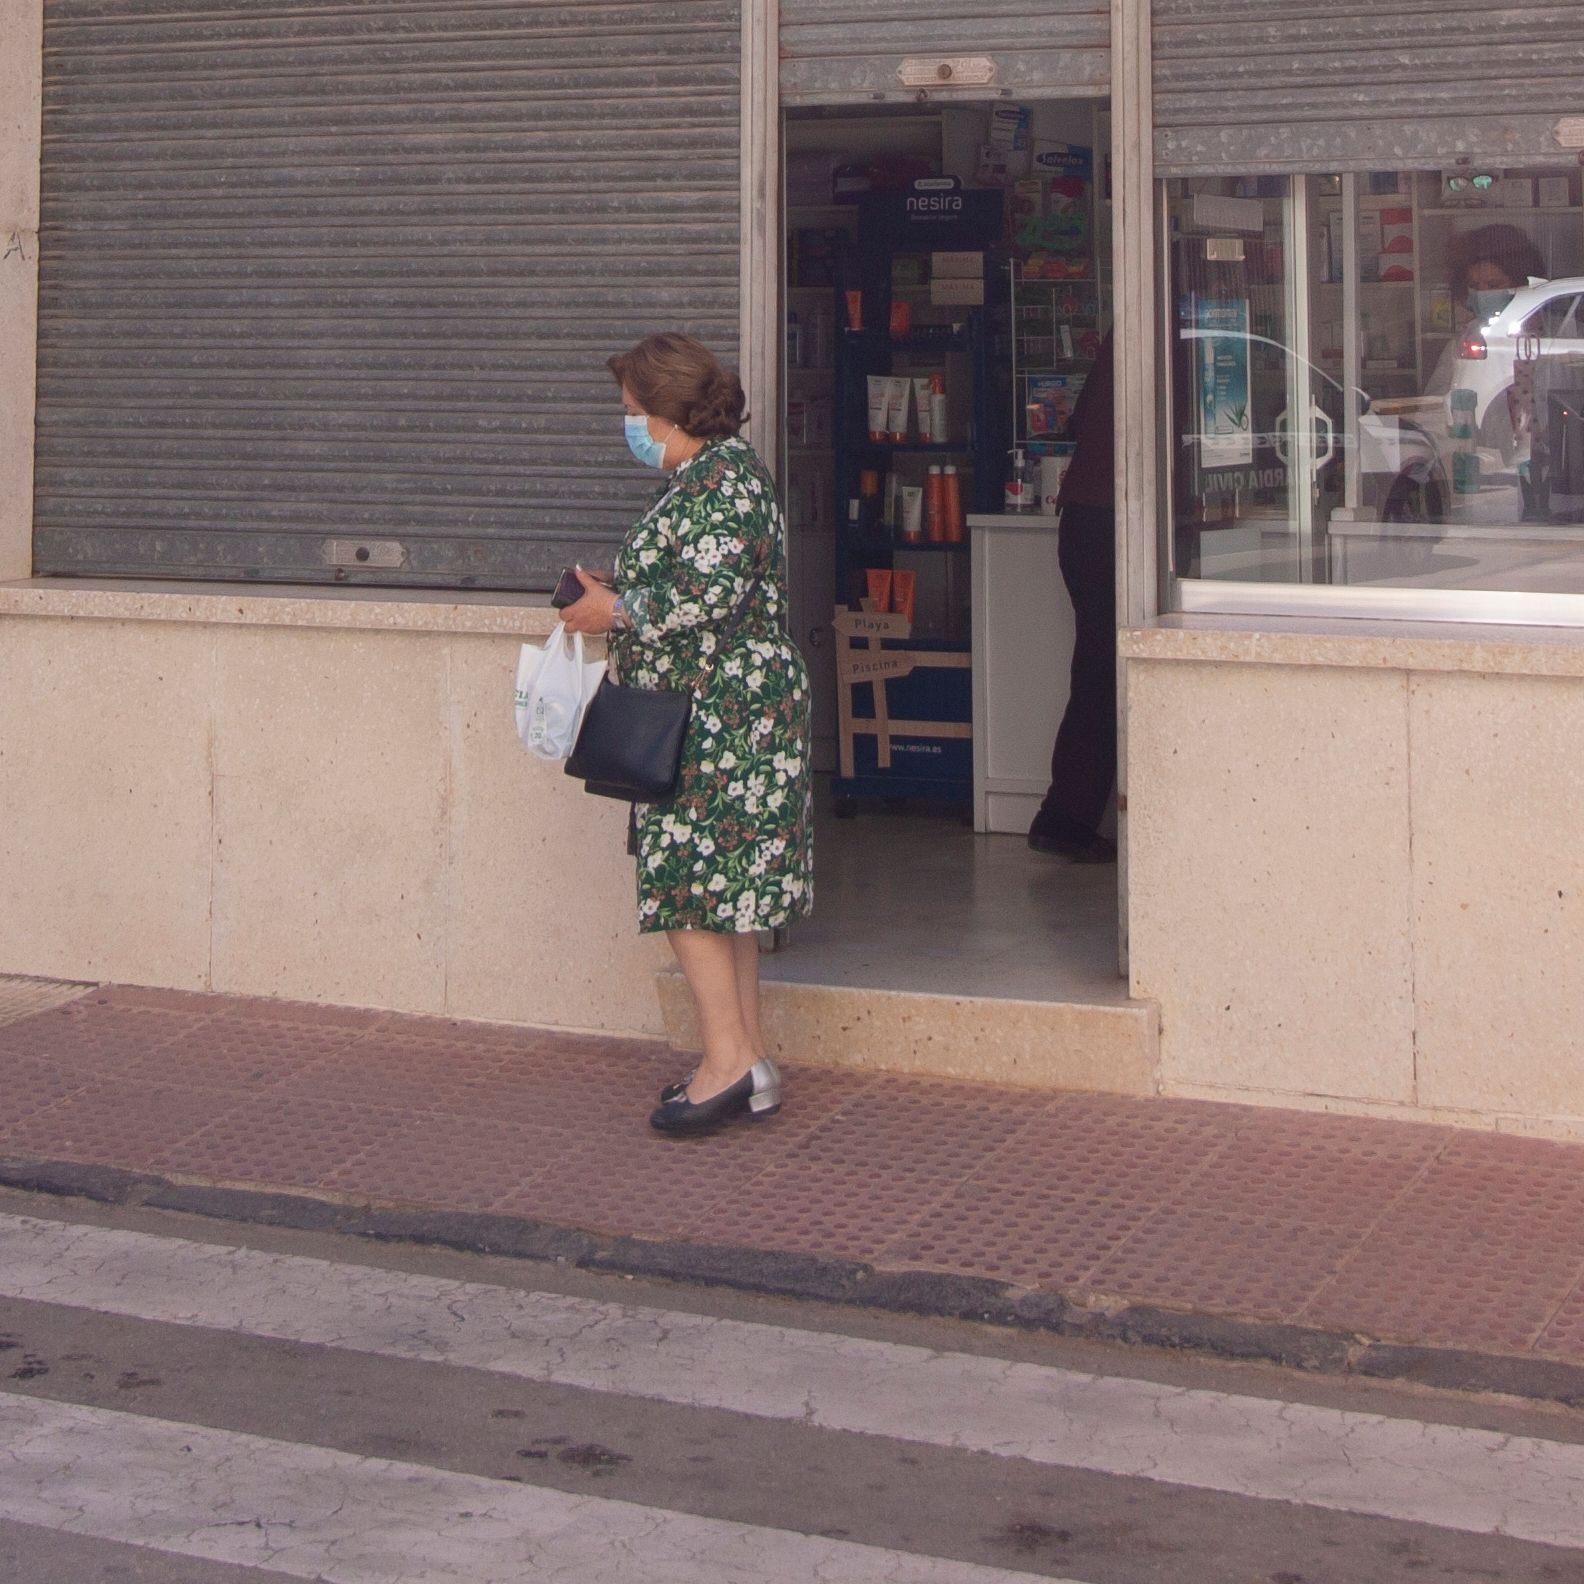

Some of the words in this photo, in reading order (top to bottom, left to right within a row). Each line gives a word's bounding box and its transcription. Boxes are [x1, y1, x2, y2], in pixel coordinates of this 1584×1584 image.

[906, 193, 962, 211] nesira
[853, 618, 891, 633] Playa
[851, 659, 899, 675] Piscina
